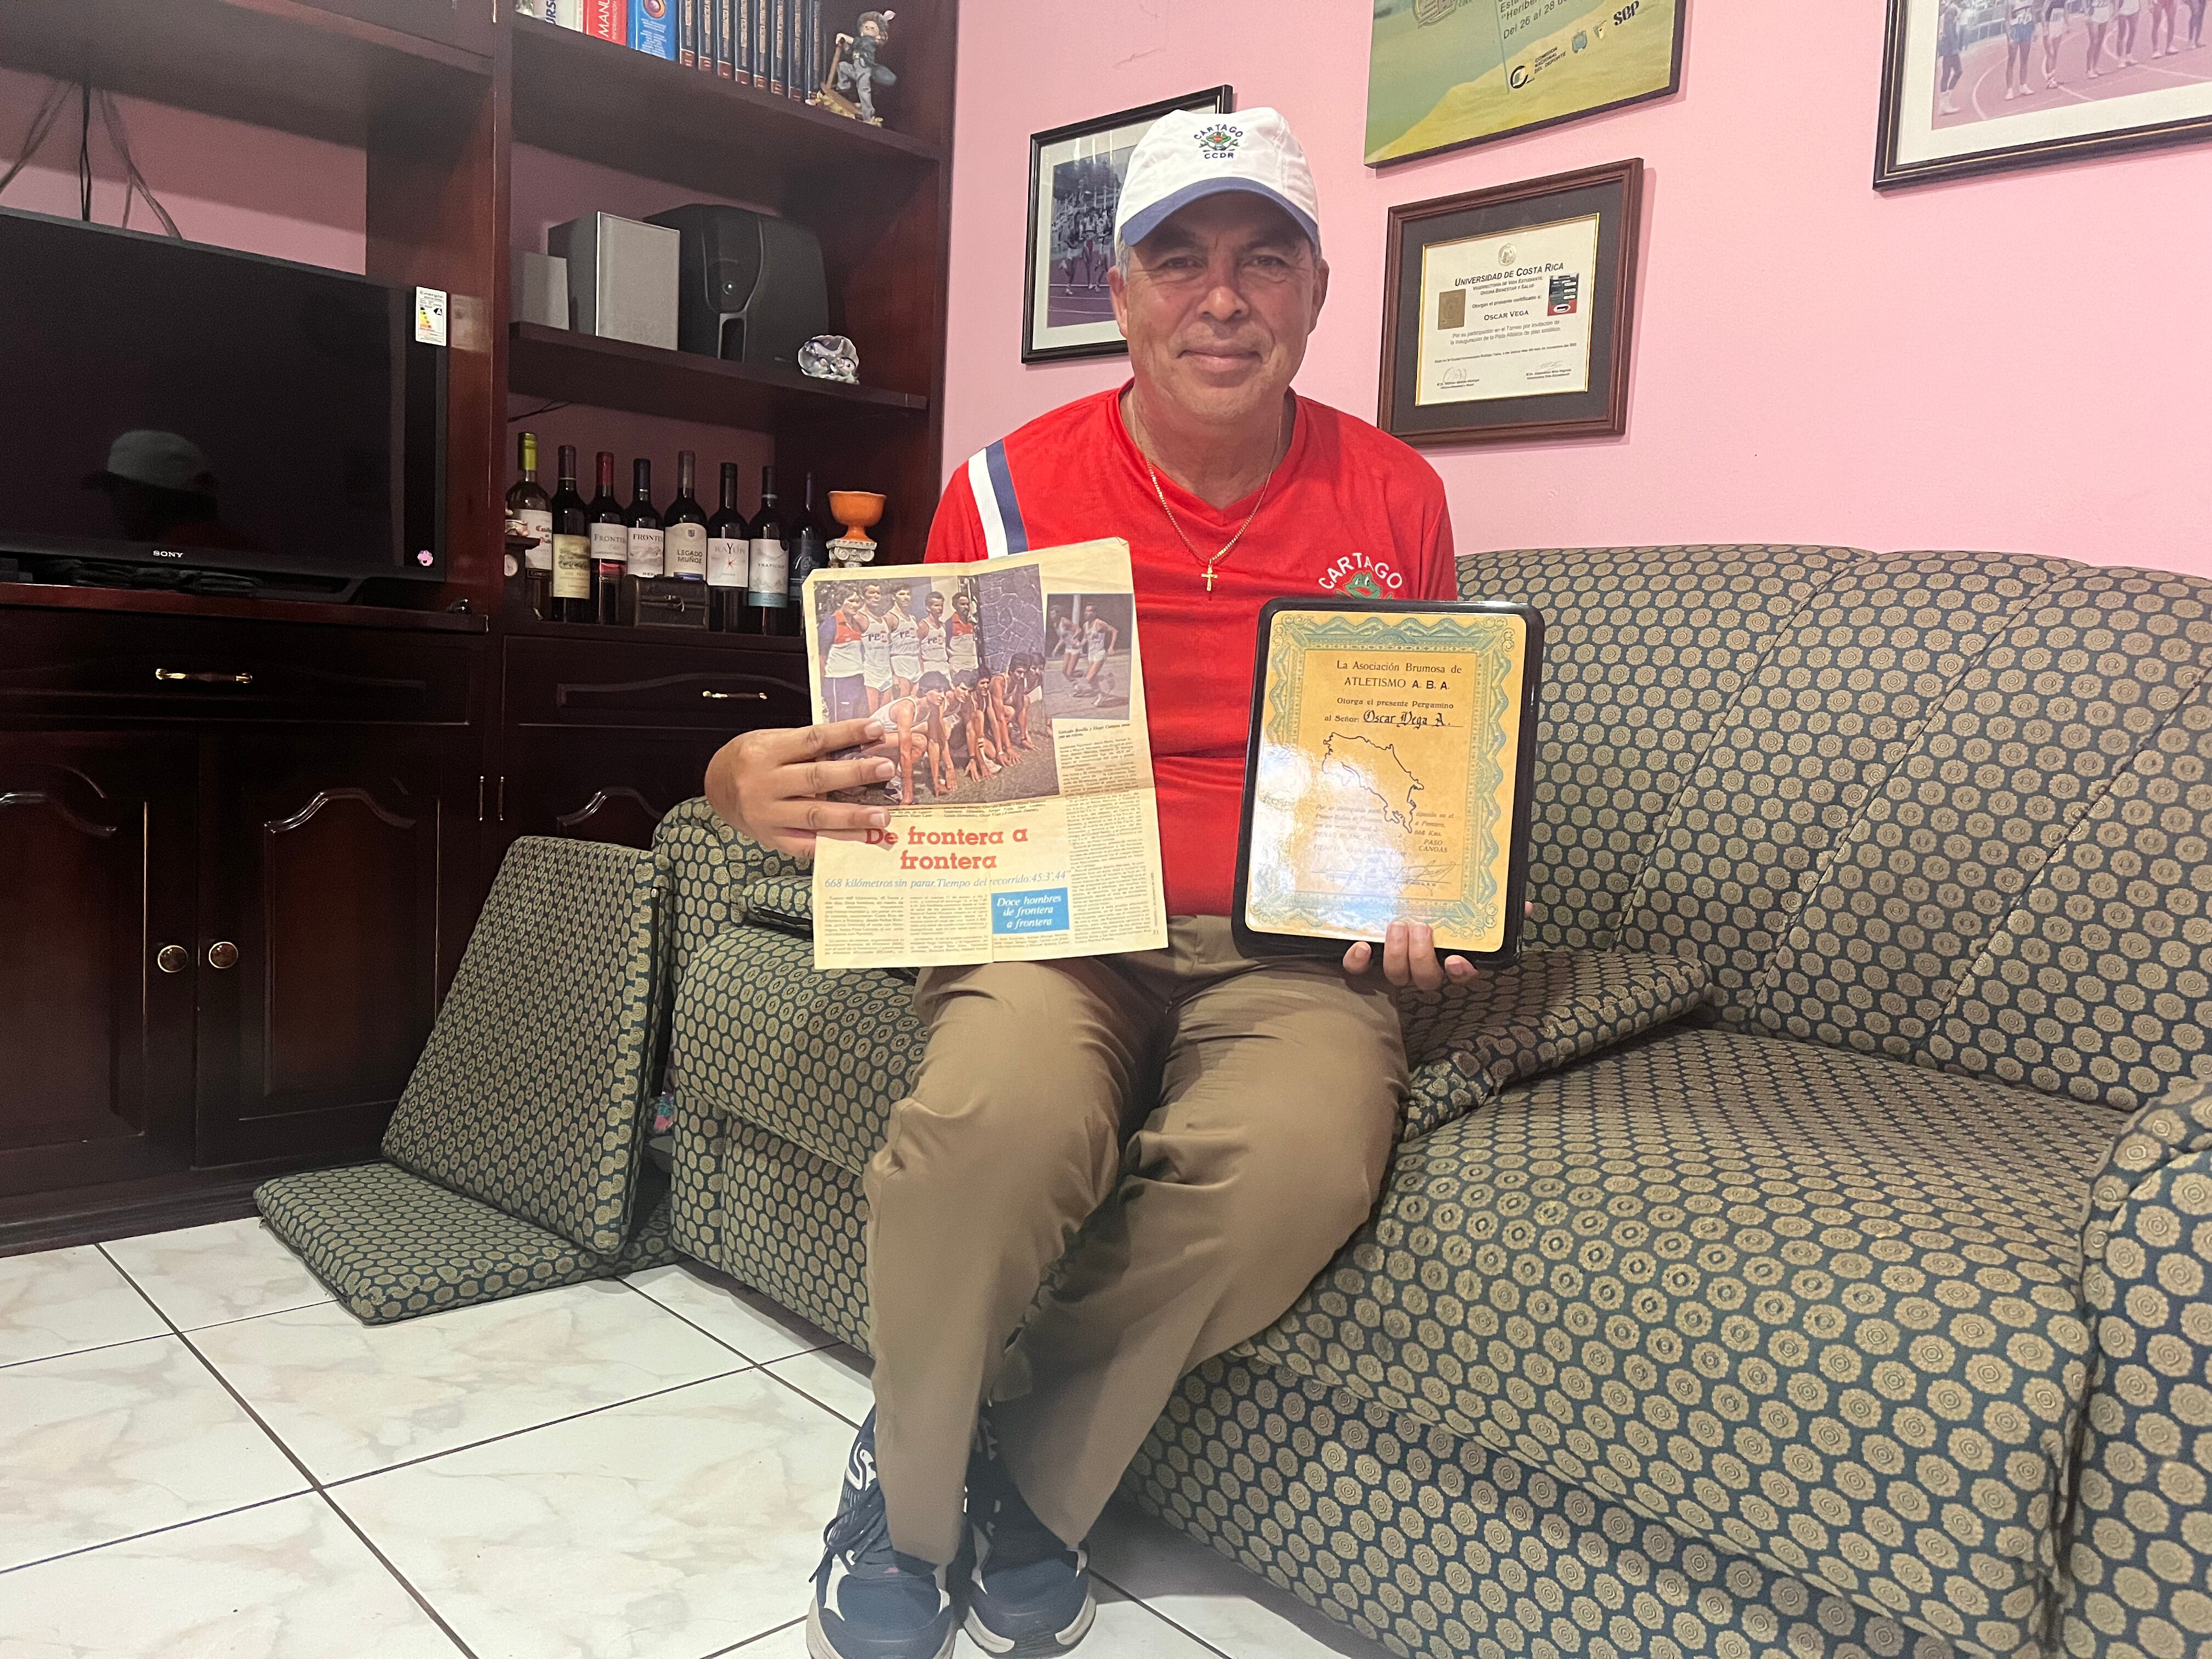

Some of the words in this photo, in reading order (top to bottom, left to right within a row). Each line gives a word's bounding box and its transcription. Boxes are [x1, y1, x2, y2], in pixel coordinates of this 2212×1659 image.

[1504, 23, 1517, 39] Del
[1520, 16, 1531, 29] 26
[1533, 8, 1542, 20] al
[1544, 1, 1555, 15] 28
[1194, 123, 1243, 140] CARTAGO
[1455, 273, 1502, 286] UNIVERSIDAD
[1504, 270, 1515, 279] DE
[1516, 266, 1543, 276] COSTA
[1544, 262, 1564, 272] RICA
[677, 549, 703, 557] LEGADO
[678, 555, 702, 564] MUÑOZ
[1318, 552, 1403, 590] CARTAGO
[1336, 660, 1348, 669] La
[1352, 661, 1400, 671] Asociación
[1406, 663, 1446, 673] Brumosa
[1451, 664, 1463, 674] de
[1345, 677, 1406, 688] ATLETISMO
[1412, 680, 1422, 689] A.
[1426, 680, 1436, 689] B.
[1440, 681, 1450, 690] A.
[1337, 697, 1363, 706] Otorga
[1412, 701, 1454, 709] Pergamino
[1335, 714, 1359, 723] Señor:
[1363, 709, 1396, 724] Oscar
[1396, 711, 1427, 729] Vega
[865, 828, 899, 845] De
[907, 826, 1004, 845] frontera
[1013, 828, 1028, 842] a
[900, 850, 997, 870] frontera
[825, 878, 842, 888] 668
[845, 877, 893, 888] kilómetros
[894, 877, 907, 888] sin
[936, 878, 970, 889] Tiempo
[973, 877, 988, 887] del
[997, 898, 1020, 906] Doce
[1024, 895, 1062, 905] hombres
[1003, 907, 1014, 916] de
[1014, 906, 1054, 919] frontera
[1013, 918, 1053, 930] frontera
